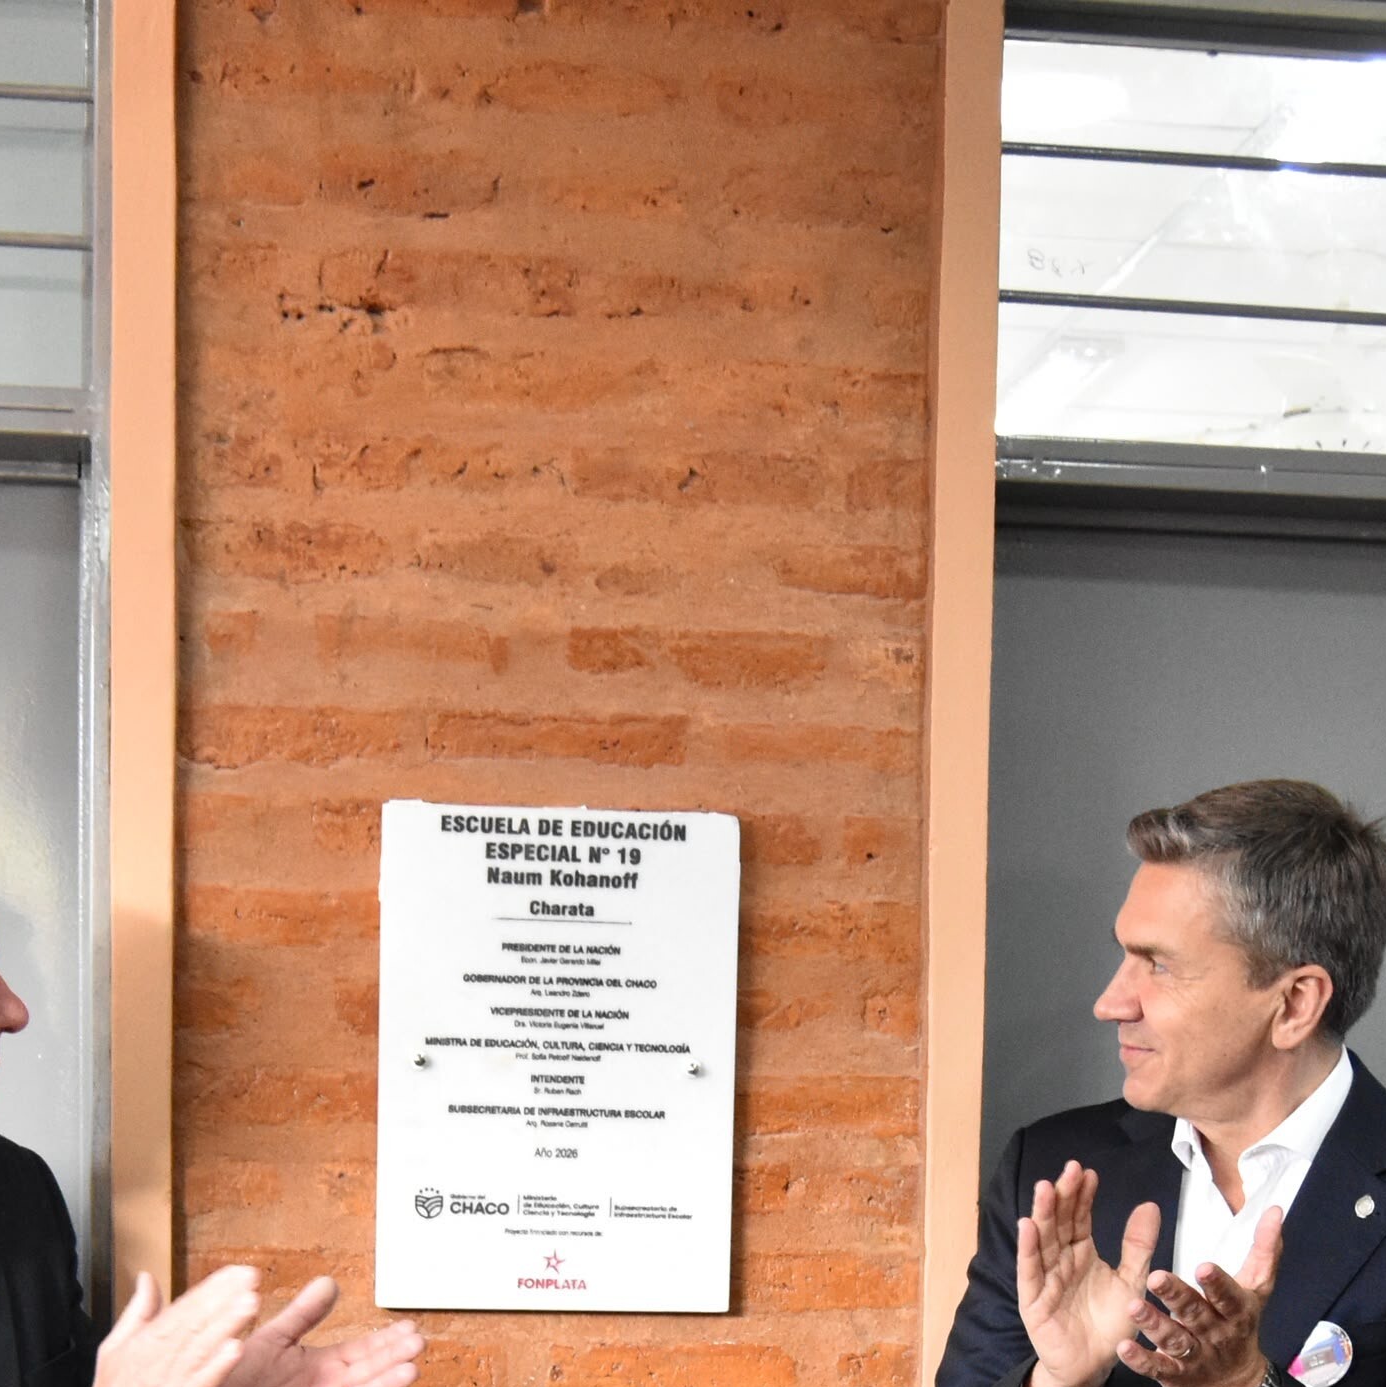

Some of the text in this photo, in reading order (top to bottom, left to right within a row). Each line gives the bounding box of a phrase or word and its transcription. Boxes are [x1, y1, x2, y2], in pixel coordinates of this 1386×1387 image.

[441, 814, 686, 841] ESCUELA DE EDUCACIÓN
[485, 841, 641, 865] ESPECIAL N° 19
[487, 866, 638, 889] Naum Kohanoff
[529, 900, 594, 917] Charata
[501, 942, 620, 955] PRESIDENTE DE LA NACIÓN
[463, 973, 526, 984] GOBERNADOR
[556, 976, 603, 986] PROVINCIA
[605, 978, 621, 987] DEL
[625, 978, 657, 989] CHACO
[490, 1006, 565, 1018] VICEPRESIDENTE
[567, 1009, 579, 1018] DE
[595, 1008, 629, 1019] NACIÓN
[554, 1021, 578, 1030] Eugenia
[425, 1036, 690, 1054] MINISTRA DE EDUCACIÓN, CULTURA, CIENCIA Y TECNOLOGÍA
[531, 1074, 584, 1084] INTENDENTE
[448, 1104, 520, 1115] SUBSECRETARIA
[538, 1107, 621, 1118] INFRAESTRUCTURA
[624, 1109, 665, 1119] ESCOLAR
[534, 1147, 552, 1158] Año
[449, 1201, 509, 1215] CHACO
[517, 1278, 586, 1289] FONPLATA
